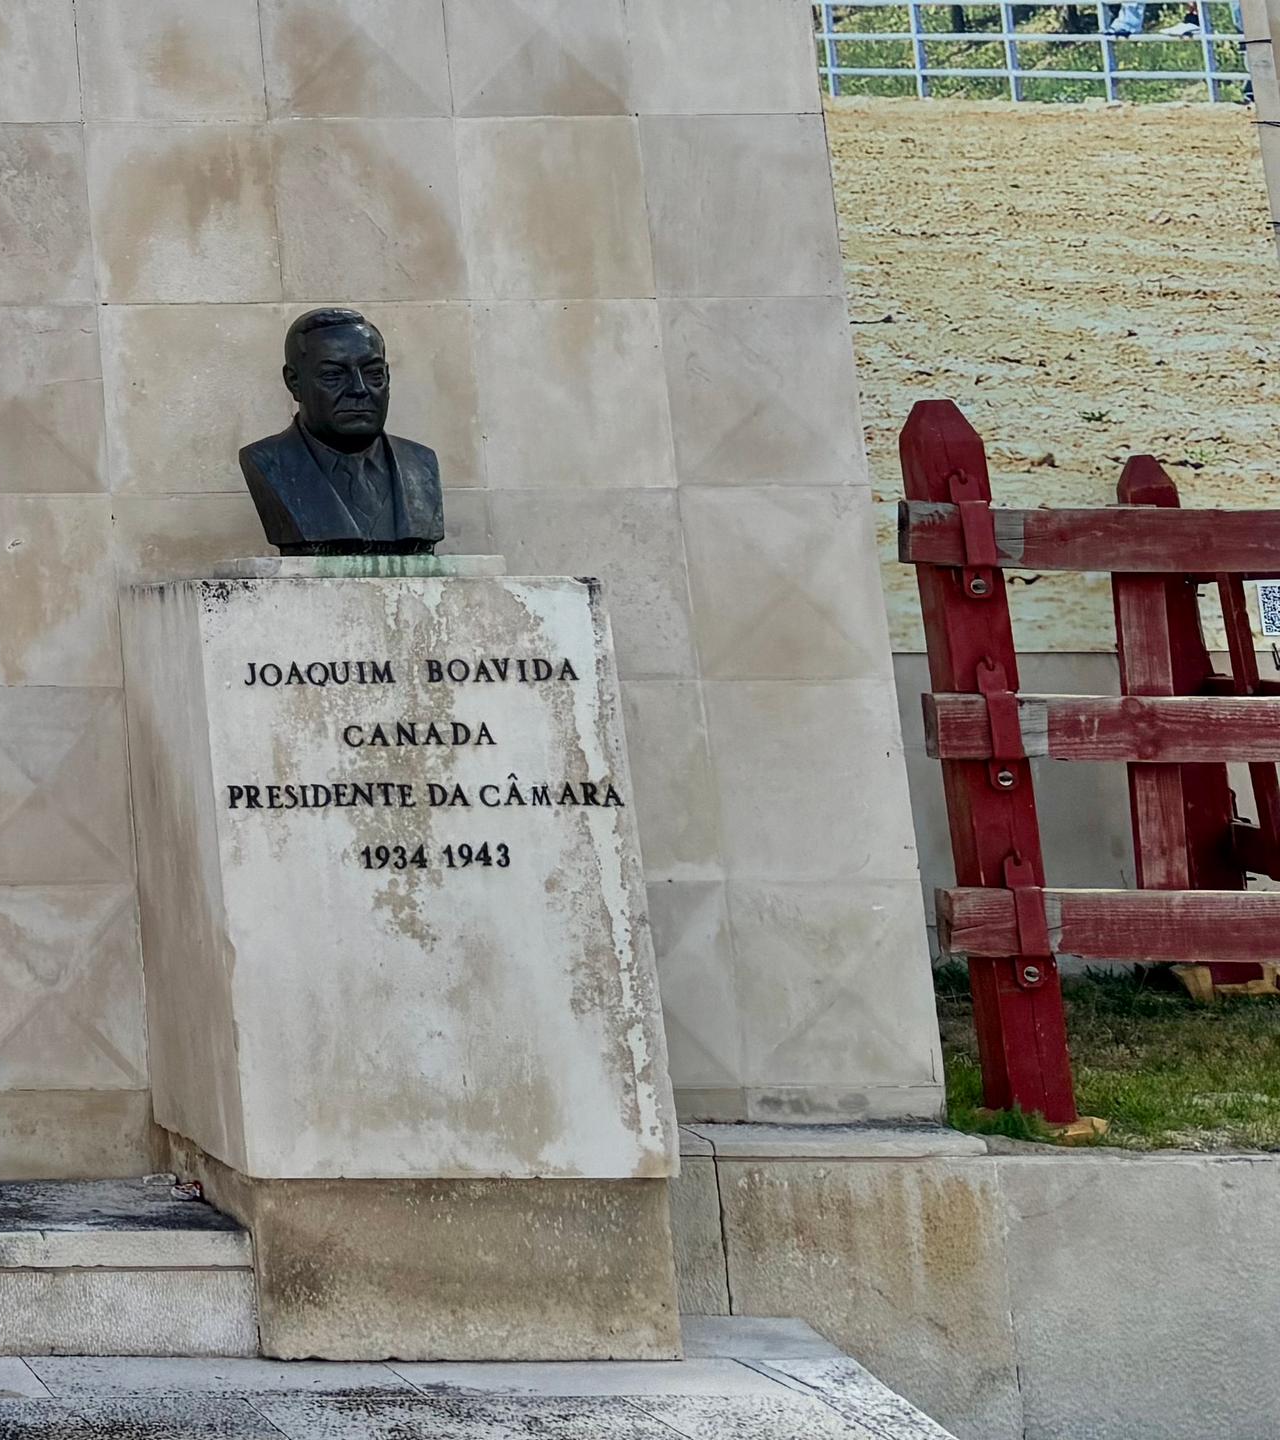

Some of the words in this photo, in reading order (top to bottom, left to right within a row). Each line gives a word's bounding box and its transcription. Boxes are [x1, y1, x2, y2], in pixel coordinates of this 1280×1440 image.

[244, 660, 396, 687] JOAQUIM
[425, 657, 580, 683] BOAVIDA
[343, 721, 497, 748] CANADA
[227, 782, 417, 809] PRESIDENTE
[426, 783, 471, 807] DA
[479, 772, 625, 808] CÂMARA
[360, 843, 428, 870] 1934
[442, 841, 511, 868] 1943
